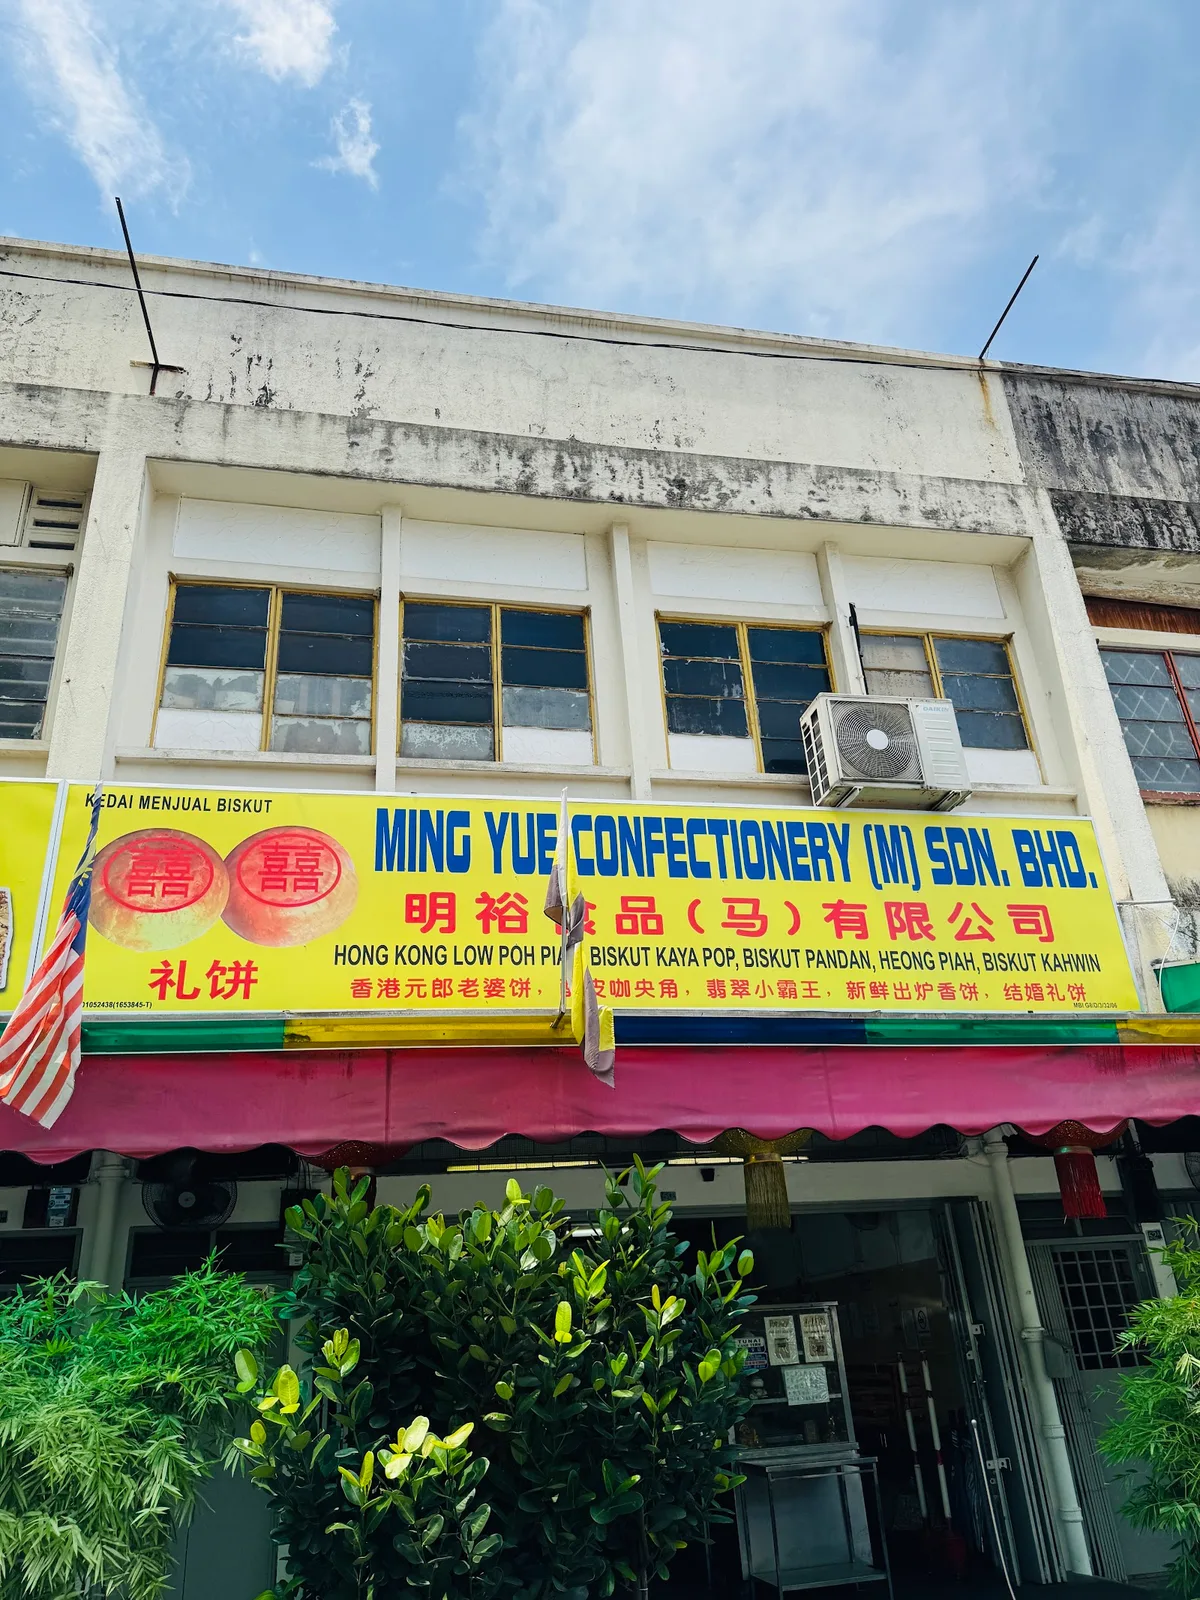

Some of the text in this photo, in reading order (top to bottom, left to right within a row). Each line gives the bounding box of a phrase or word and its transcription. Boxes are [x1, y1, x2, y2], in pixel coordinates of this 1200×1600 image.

[85, 792, 273, 813] KEDAI MENJUAL BISKUT
[375, 808, 1098, 891] MING YUE CONFECTIONERY (M) SDN. BHD.
[334, 944, 389, 966] HONG
[394, 944, 448, 966] KONG
[453, 945, 494, 966] LOW
[499, 945, 535, 966] POH
[590, 946, 651, 967] BISKUT
[656, 946, 700, 967] KAYA
[702, 947, 739, 971] POP,
[743, 948, 801, 968] BISKUT
[805, 949, 876, 973] PANDAN,
[878, 950, 936, 971] HEONG
[938, 951, 981, 974] PIAH,
[982, 952, 1037, 972] BISKUT
[1040, 953, 1101, 973] KAHWIN
[148, 959, 259, 1001] 礼饼
